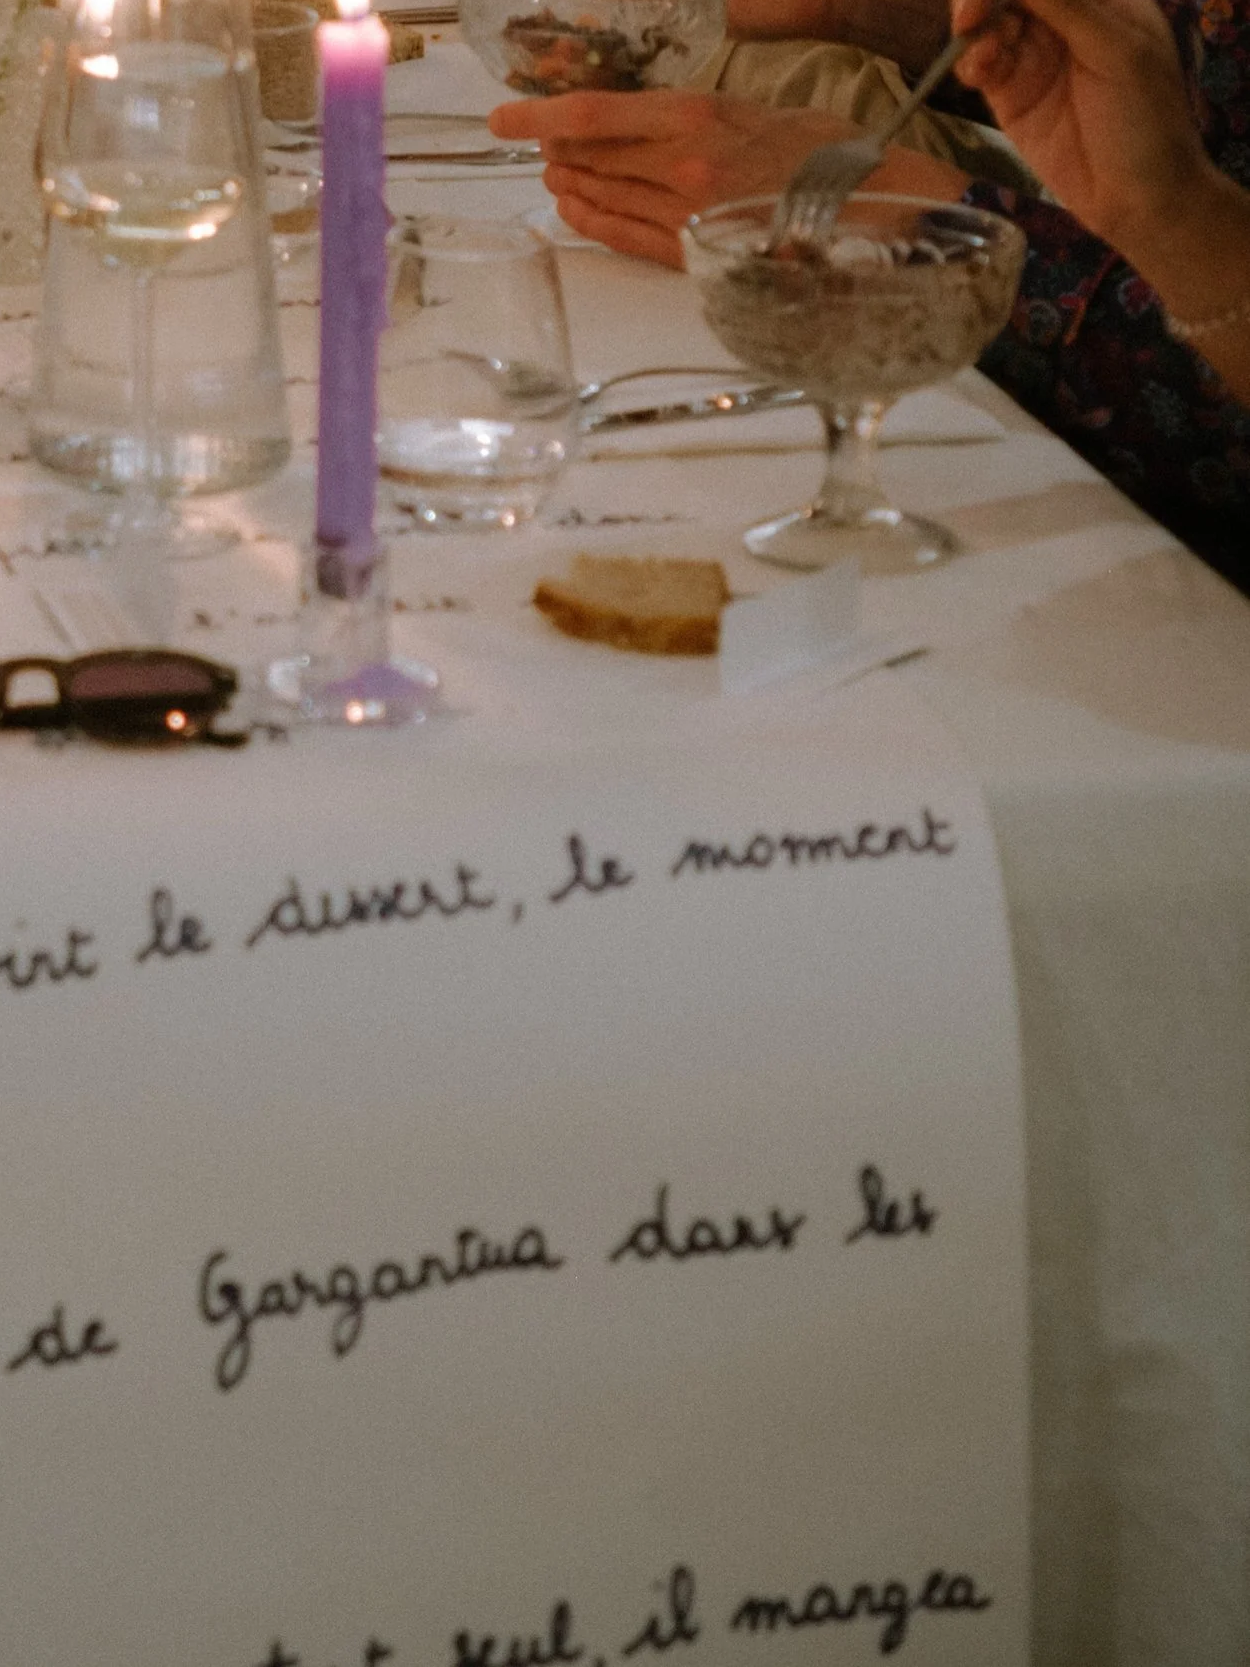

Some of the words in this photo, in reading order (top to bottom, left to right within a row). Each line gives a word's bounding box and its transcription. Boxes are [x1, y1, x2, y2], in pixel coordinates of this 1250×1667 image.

[136, 886, 212, 964] le
[245, 864, 525, 948] dessert,
[548, 832, 634, 904] le
[669, 807, 957, 878] moment
[4, 1304, 120, 1374] de
[199, 1224, 566, 1393] Gargantua
[610, 1181, 808, 1265] dans
[844, 1162, 942, 1248] les
[622, 1562, 702, 1658] il
[728, 1568, 995, 1658] mangea
